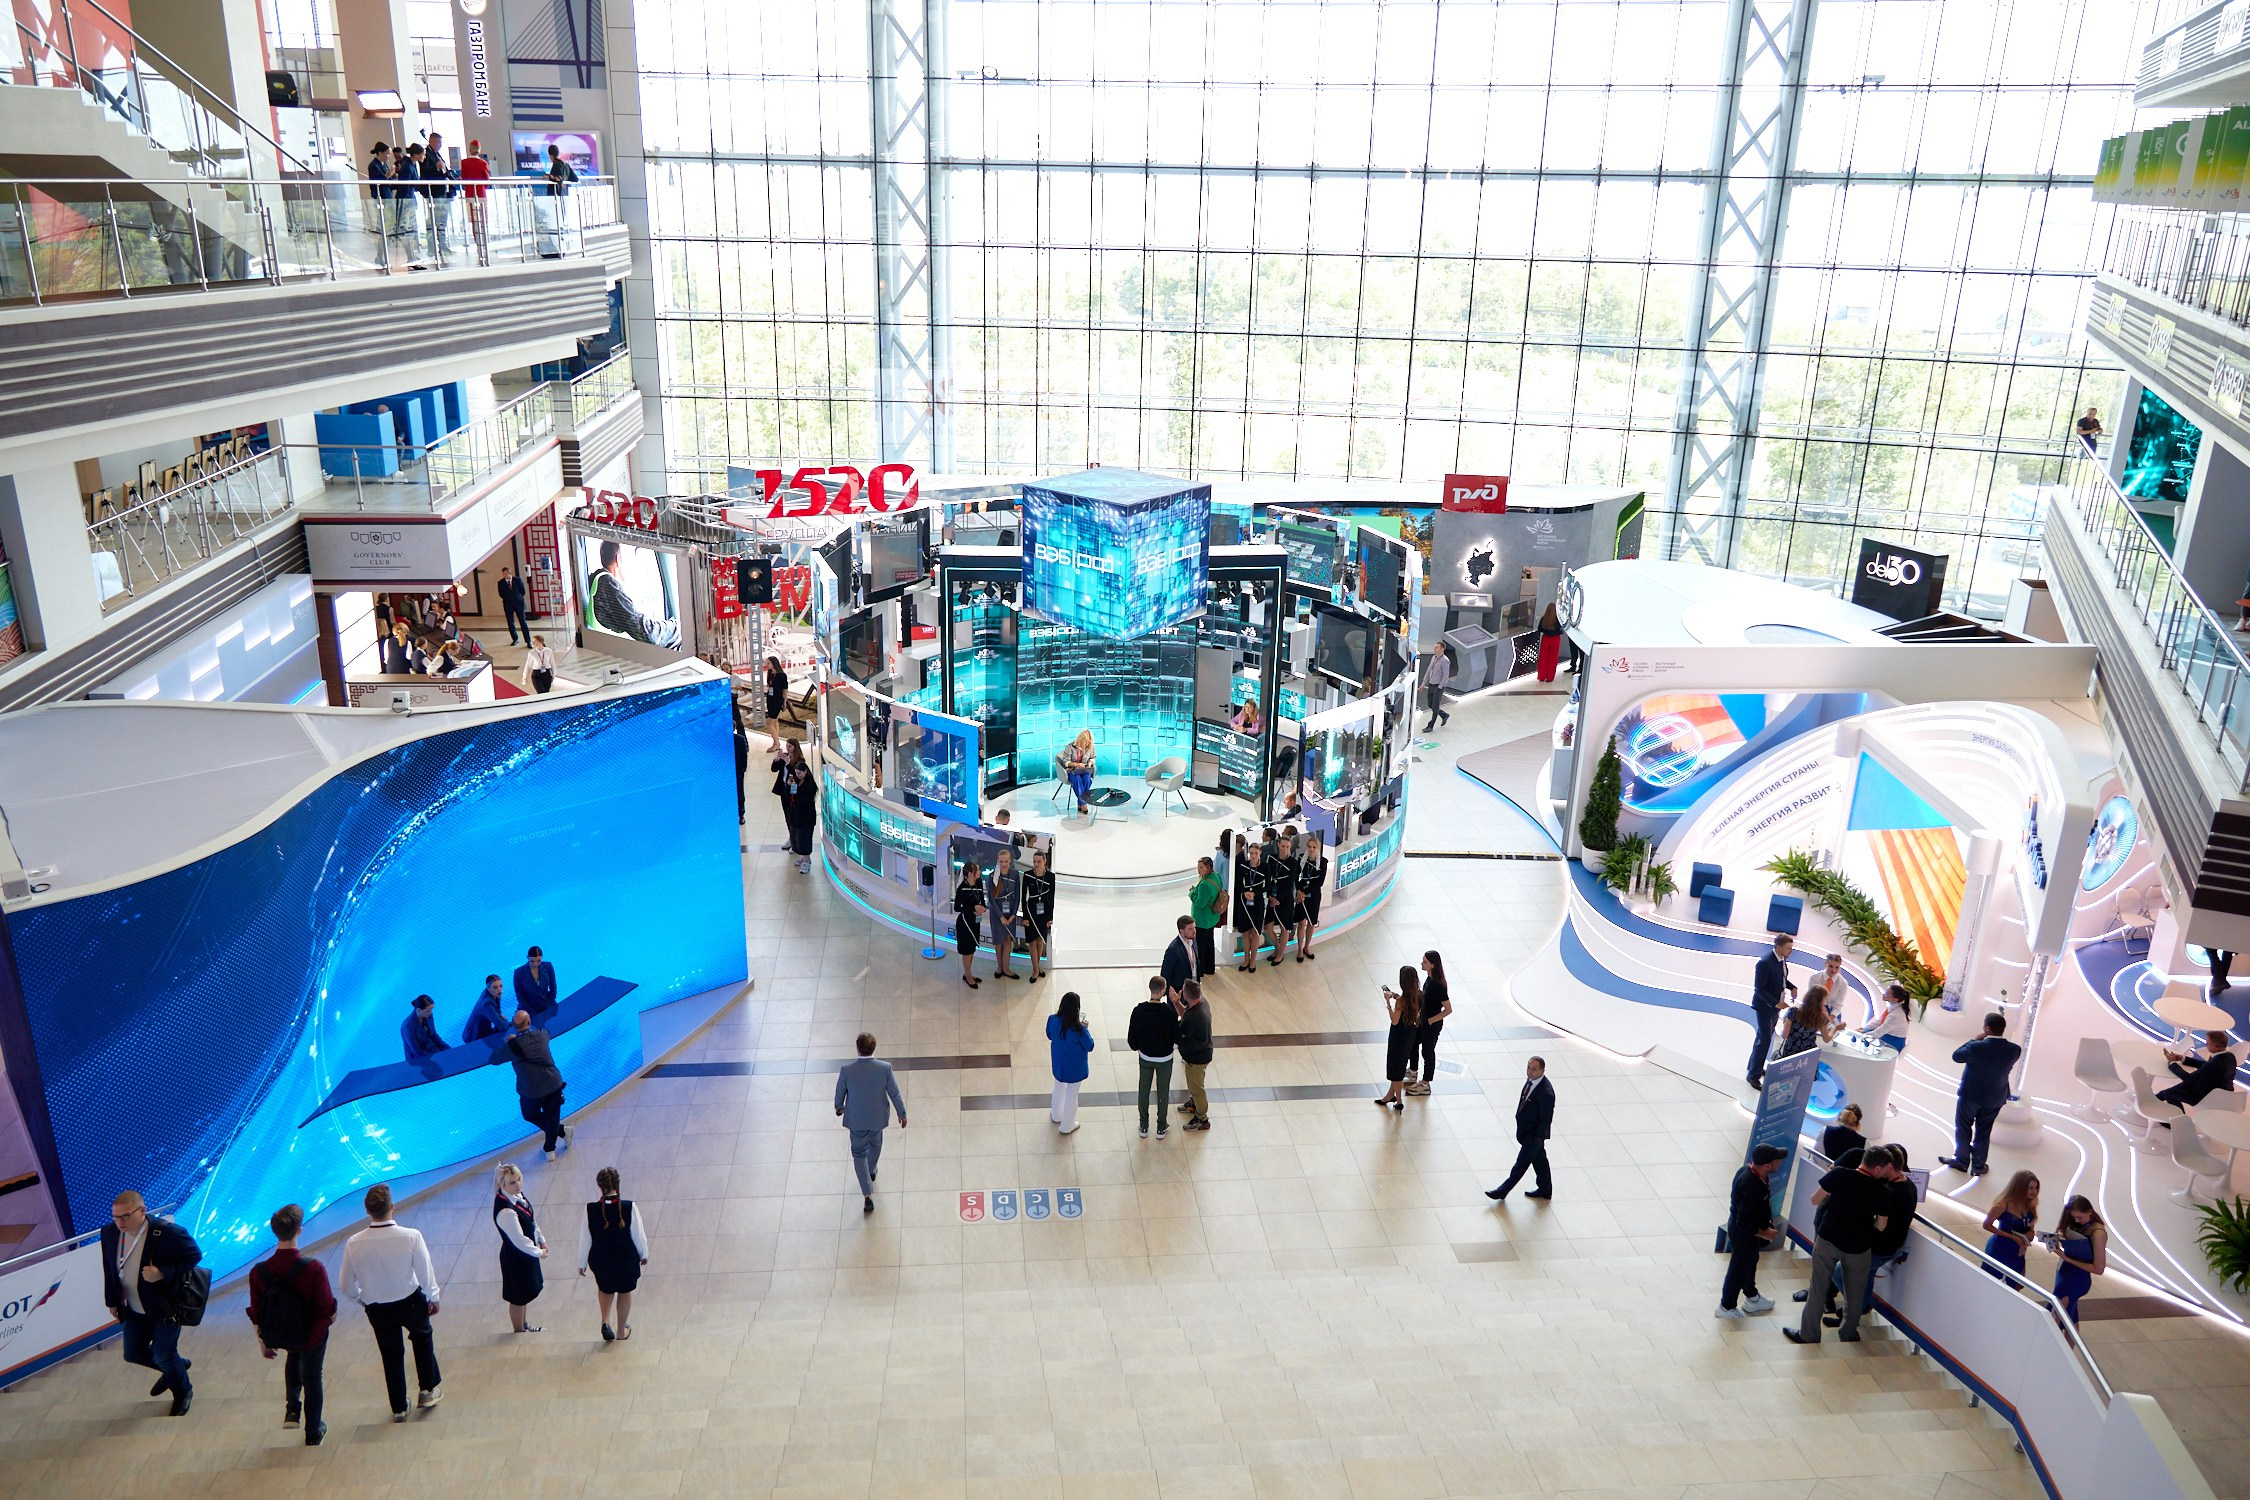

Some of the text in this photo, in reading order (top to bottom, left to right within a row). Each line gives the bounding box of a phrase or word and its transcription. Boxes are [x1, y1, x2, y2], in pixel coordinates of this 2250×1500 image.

[468, 20, 491, 117] ГАЗПРОМБАНК
[581, 486, 658, 530] 1520
[755, 463, 919, 519] 1520
[1711, 760, 1819, 838] ЗЕЛЕНАЯ ЭНЕРГИЯ СТРАНЫ
[1747, 805, 1793, 838] ЭНЕРГИЯ
[1780, 1057, 1809, 1071] LEVEL A4
[967, 1192, 1074, 1206] S D C B
